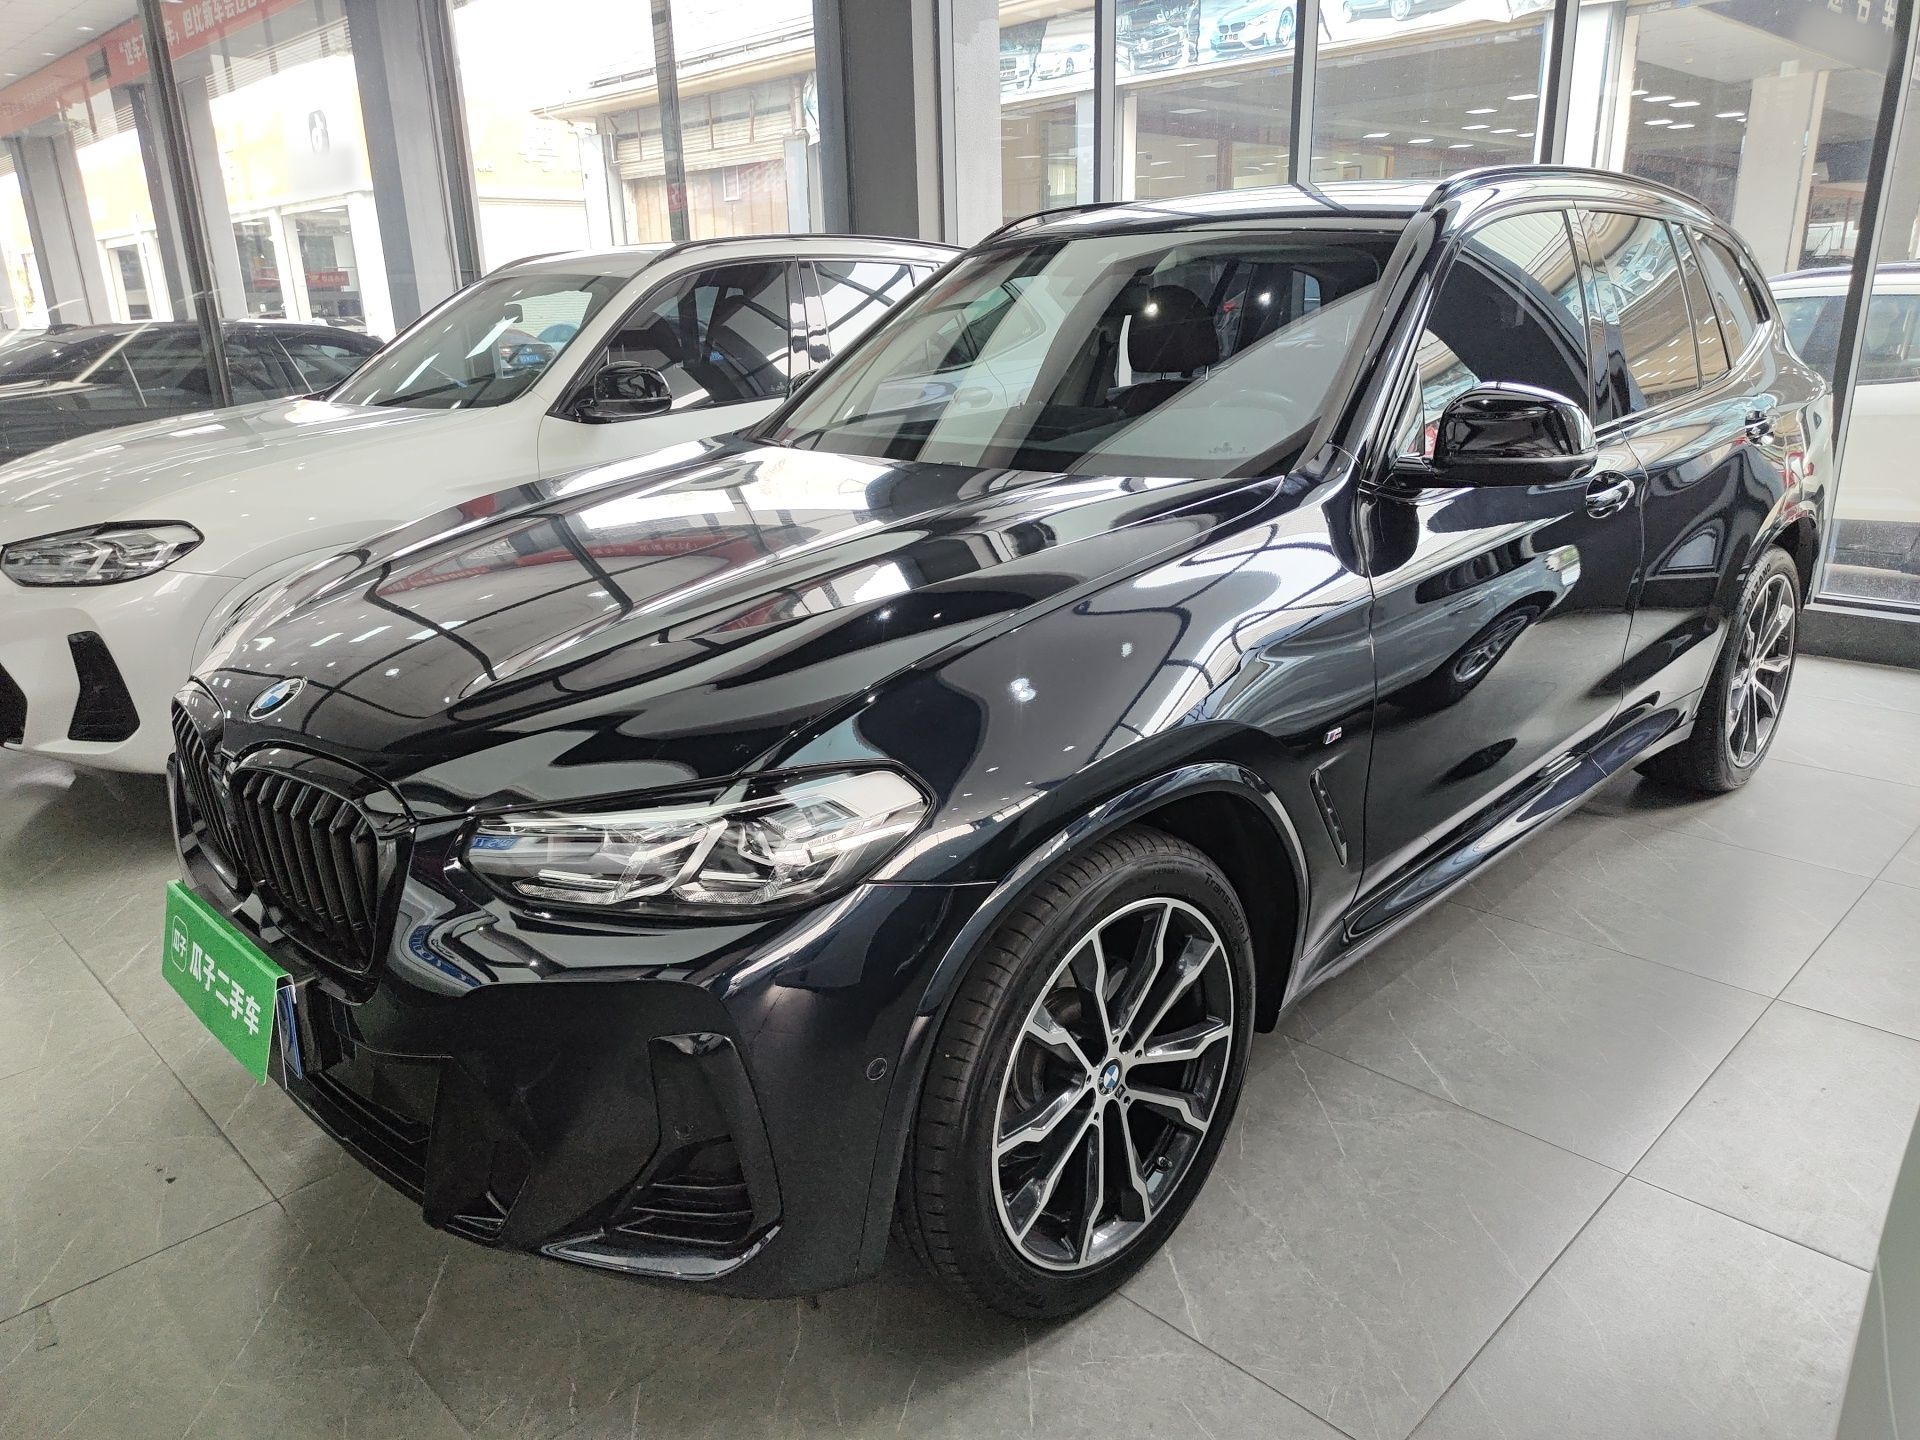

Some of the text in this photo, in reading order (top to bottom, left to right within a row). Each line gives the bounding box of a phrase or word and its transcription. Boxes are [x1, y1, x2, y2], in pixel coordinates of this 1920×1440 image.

[172, 927, 187, 958] 瓜子
[189, 941, 261, 1036] 瓜子二手车
